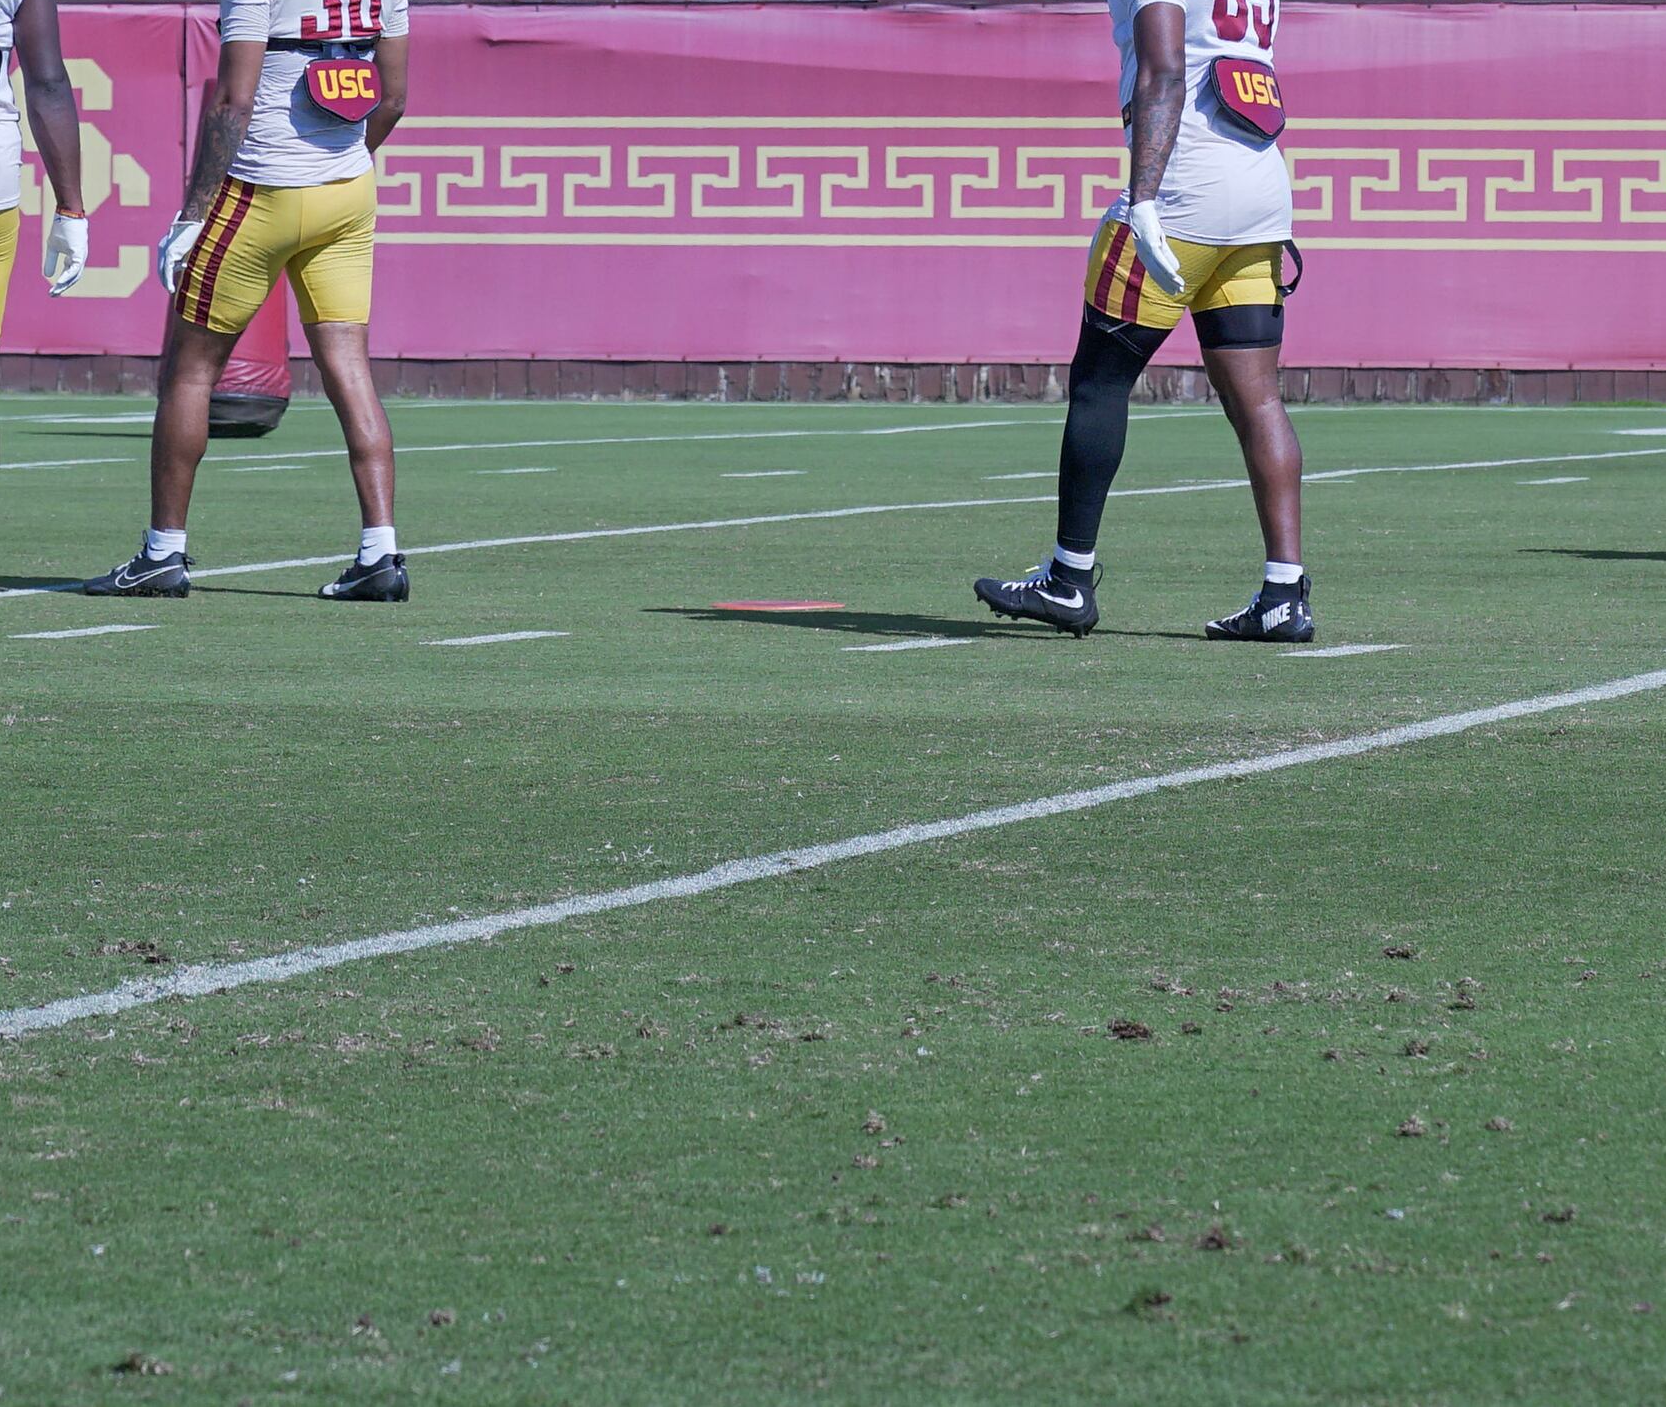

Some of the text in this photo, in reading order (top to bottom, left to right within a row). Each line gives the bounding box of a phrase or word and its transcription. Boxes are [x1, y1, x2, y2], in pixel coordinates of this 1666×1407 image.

[317, 68, 376, 100] USC
[1232, 70, 1282, 109] USC
[1261, 601, 1291, 634] NIKE
